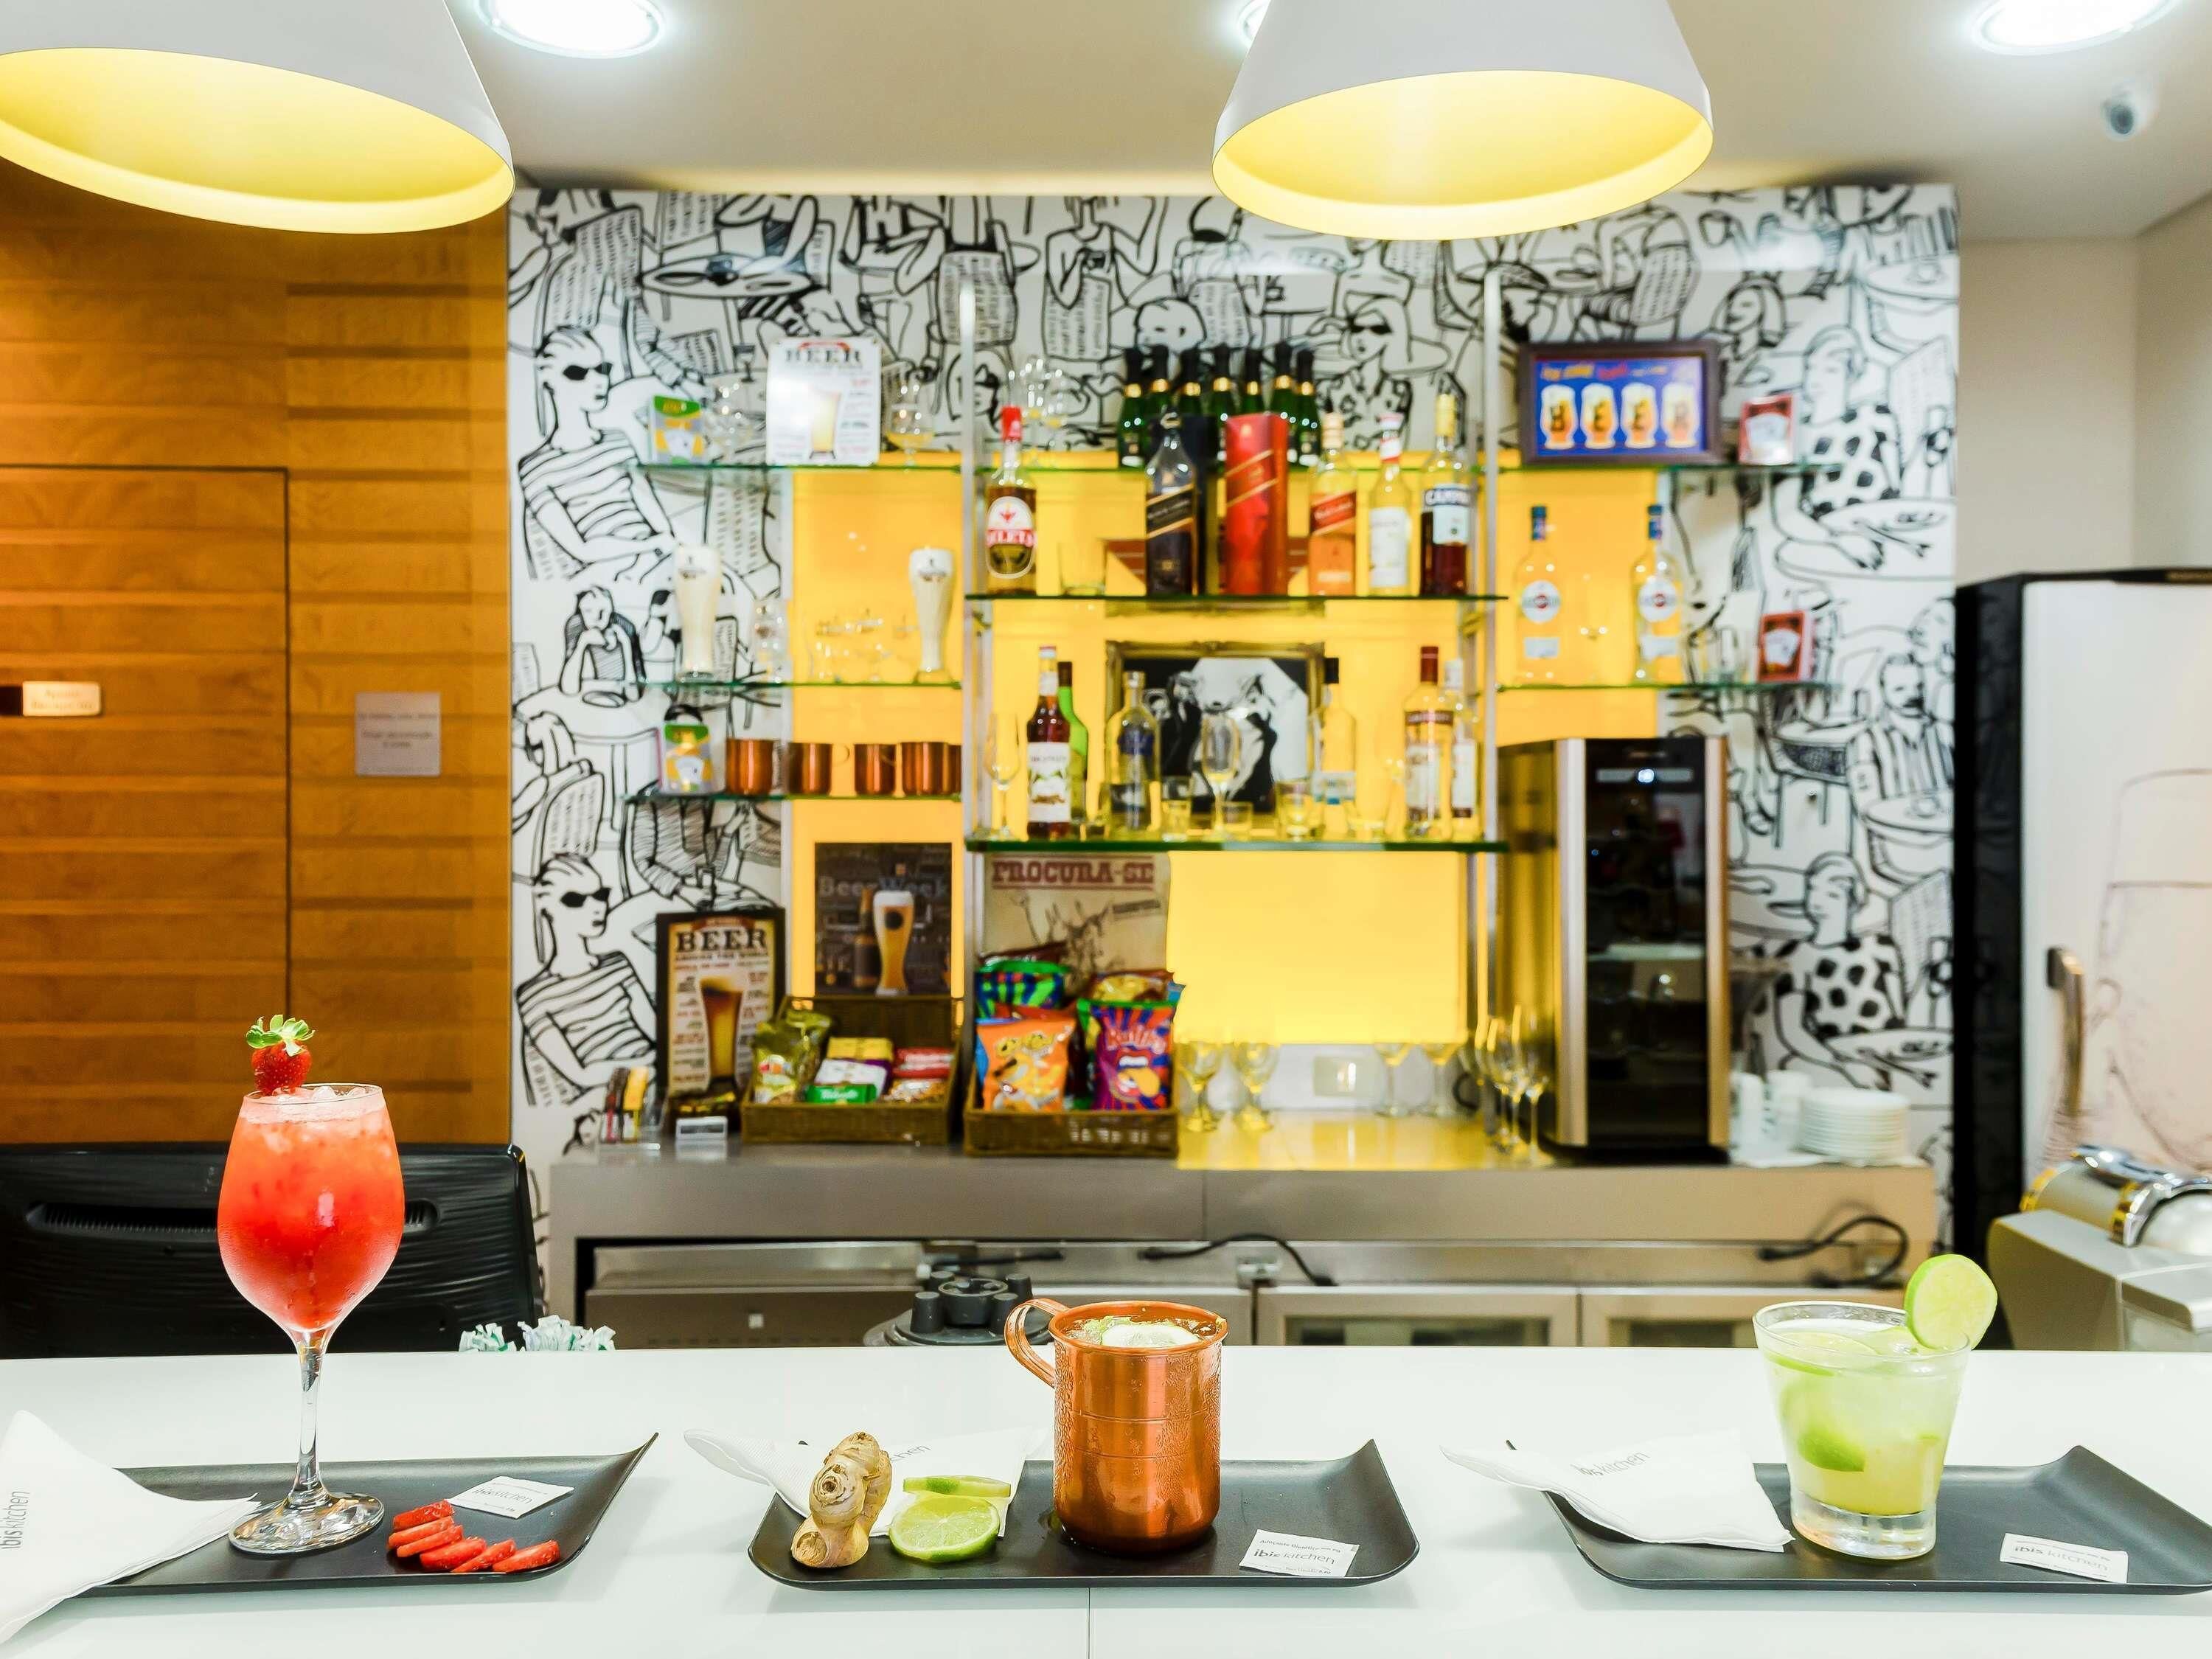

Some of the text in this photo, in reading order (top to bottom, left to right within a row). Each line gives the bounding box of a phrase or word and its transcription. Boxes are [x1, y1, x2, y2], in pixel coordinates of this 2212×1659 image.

[785, 348, 861, 364] BEER
[992, 860, 1154, 883] PROCURA-SE
[677, 929, 766, 951] BEER
[1253, 1548, 1336, 1565] ibis kitchen
